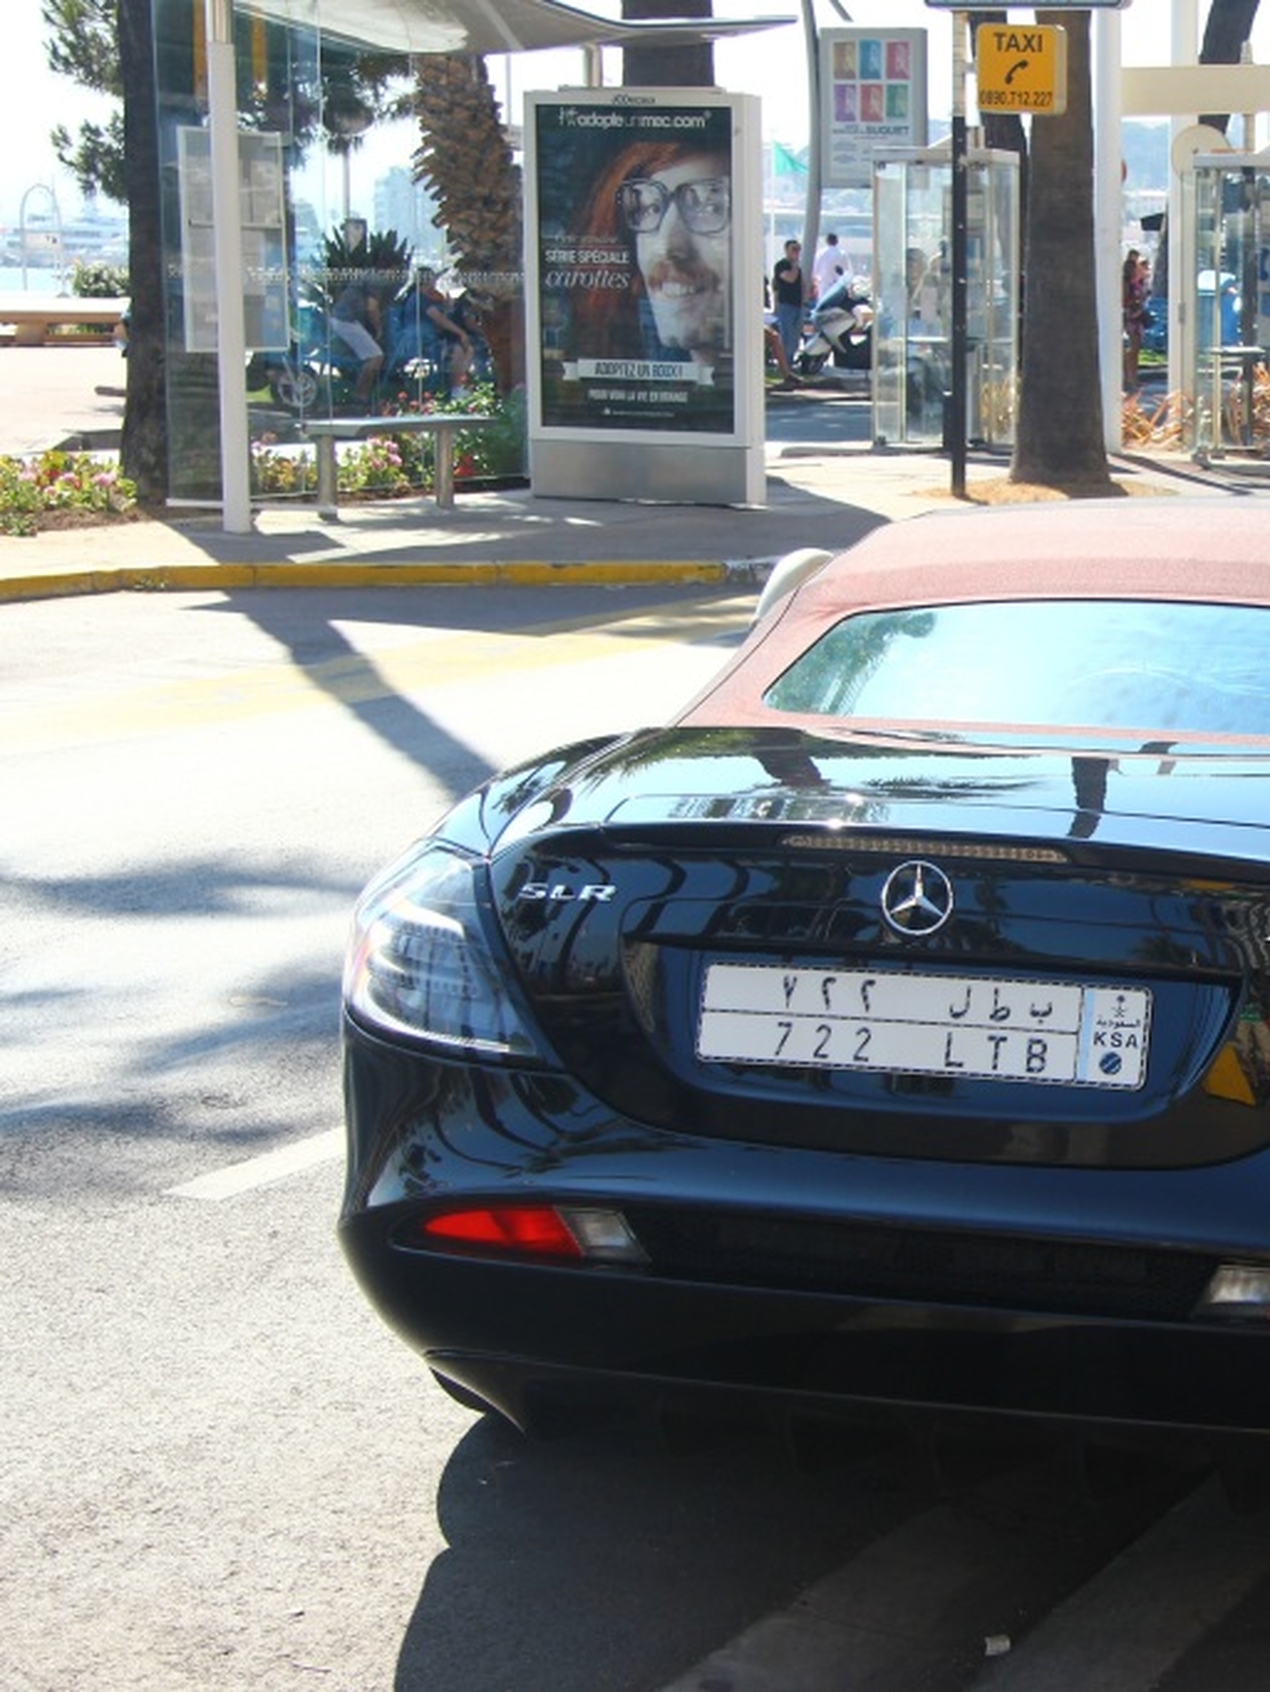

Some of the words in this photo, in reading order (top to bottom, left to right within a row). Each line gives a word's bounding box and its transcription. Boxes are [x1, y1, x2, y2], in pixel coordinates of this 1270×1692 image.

[994, 33, 1043, 52] TAXI
[518, 883, 617, 901] SLR
[774, 1021, 872, 1063] 722
[943, 1031, 1048, 1074] LTB
[1093, 1030, 1138, 1049] KSA
